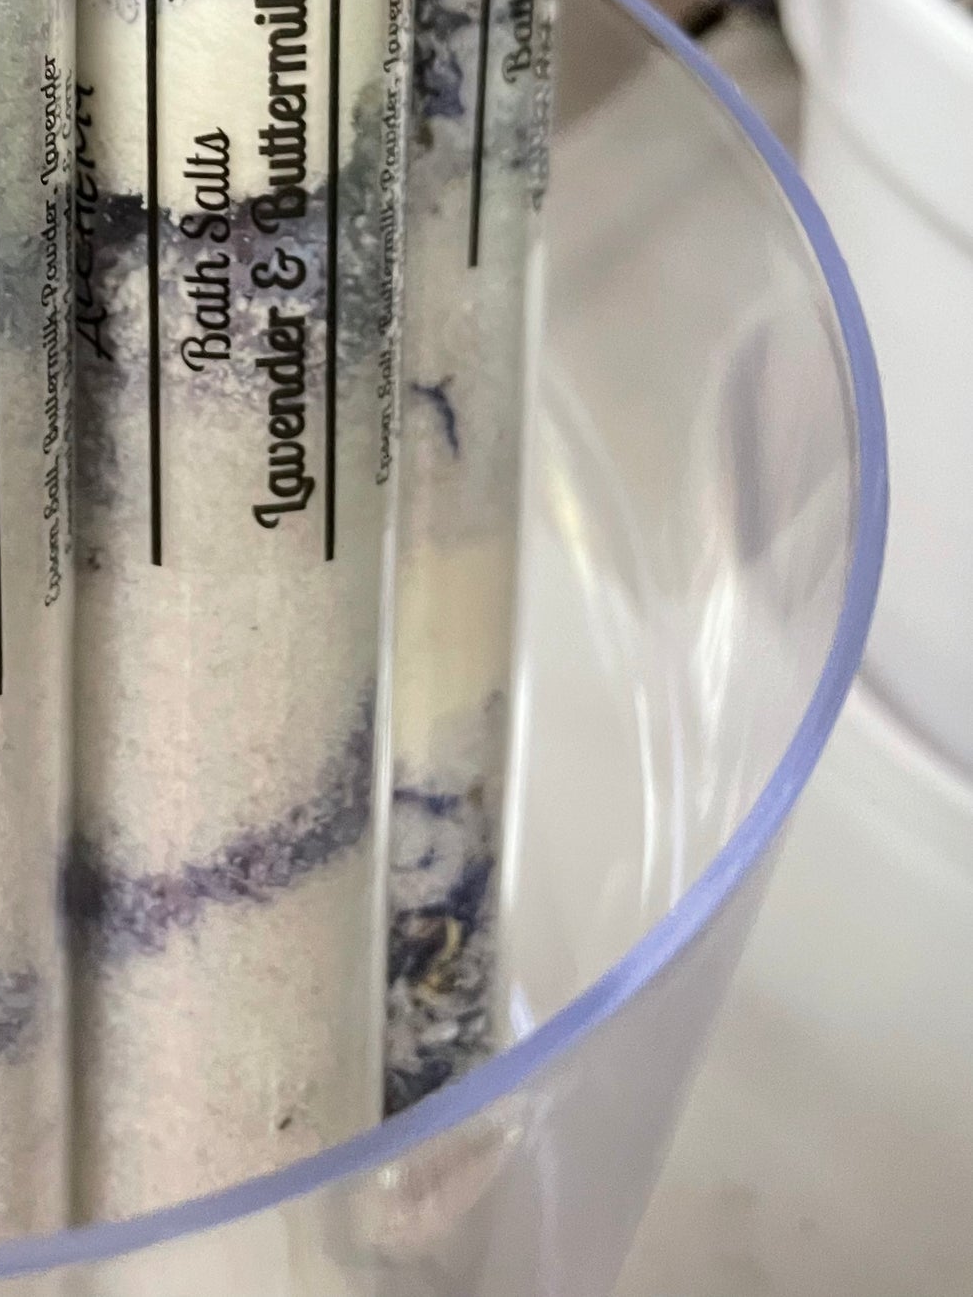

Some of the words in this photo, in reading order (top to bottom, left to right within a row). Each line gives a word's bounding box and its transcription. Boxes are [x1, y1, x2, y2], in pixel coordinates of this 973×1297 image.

[40, 55, 59, 185] Lavender
[180, 126, 231, 243] Salts
[181, 253, 231, 372] Bath
[252, 247, 306, 291] &
[252, 306, 315, 529] Lavender
